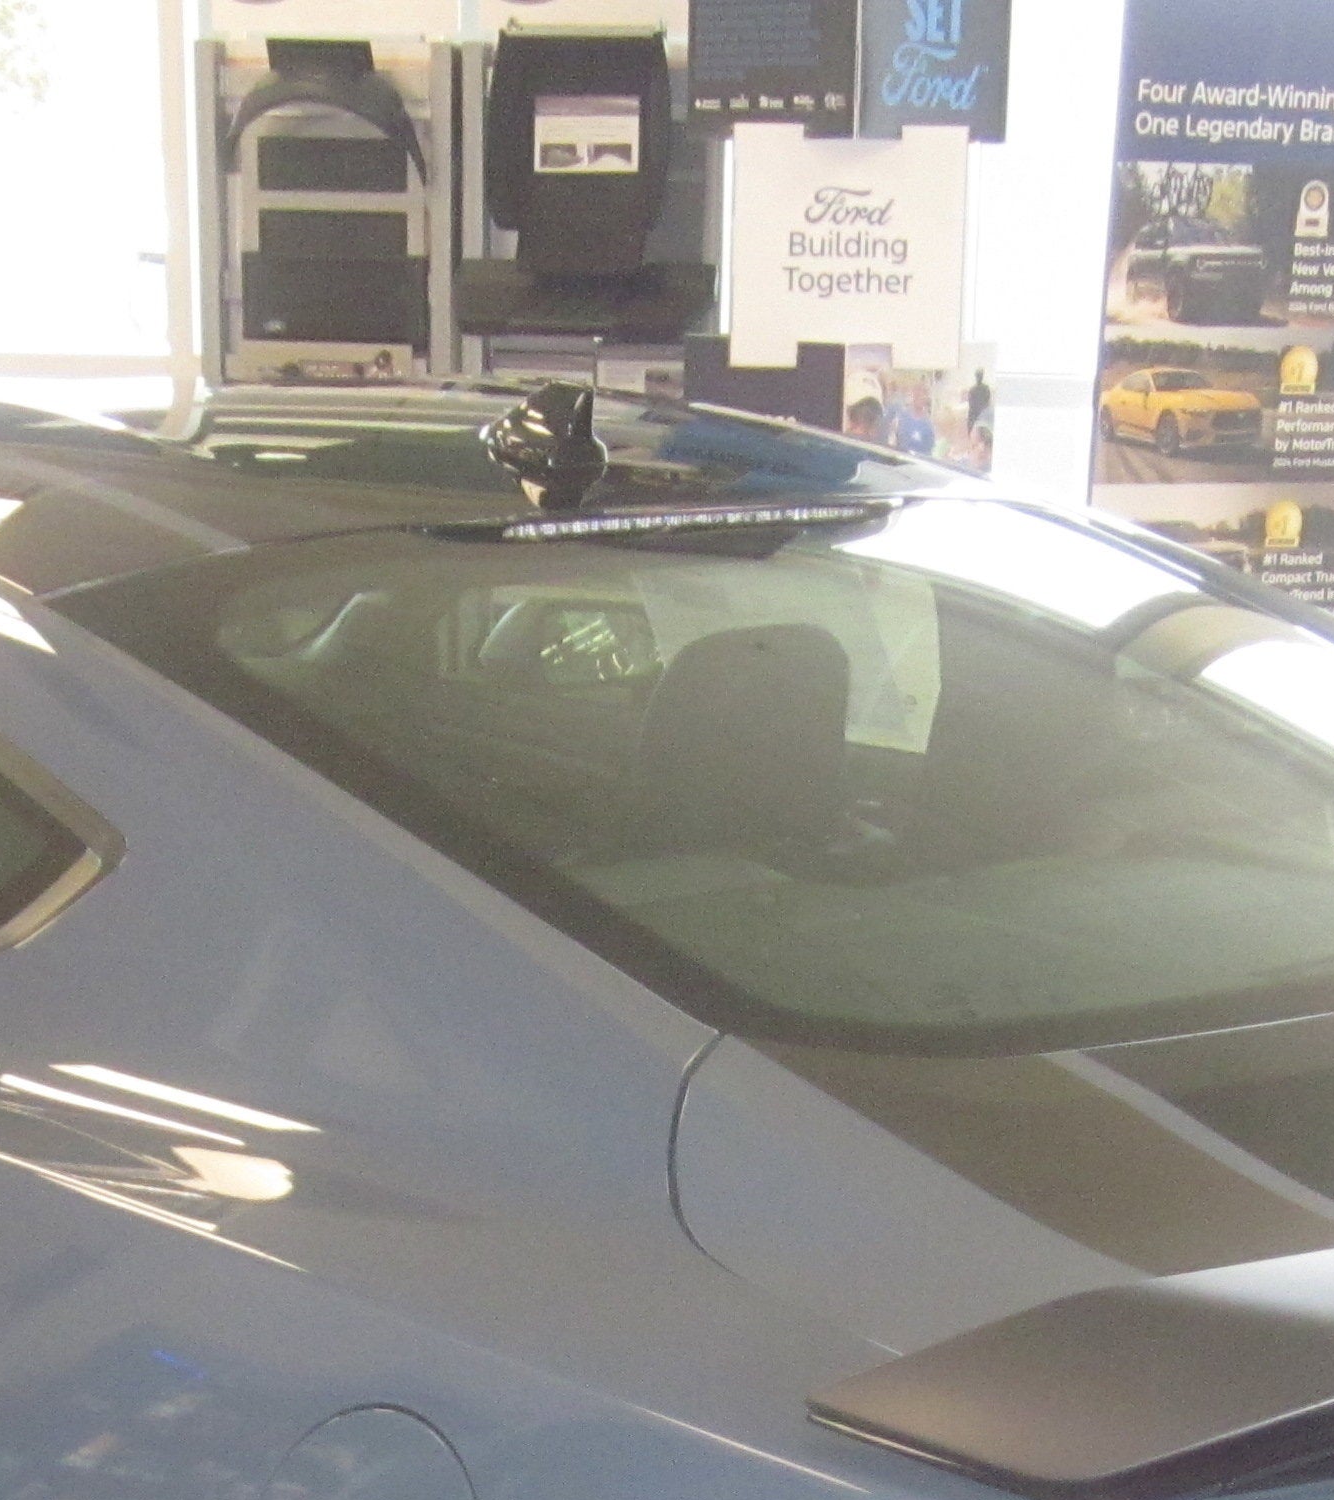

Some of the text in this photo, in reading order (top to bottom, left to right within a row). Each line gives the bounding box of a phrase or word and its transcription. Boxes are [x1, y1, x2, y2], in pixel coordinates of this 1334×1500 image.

[882, 42, 980, 110] Ford
[1137, 78, 1187, 103] Four
[1135, 111, 1179, 136] One
[1185, 114, 1294, 145] Legendary
[804, 186, 895, 225] Ford
[789, 231, 908, 264] Building
[1292, 261, 1320, 275] New
[782, 266, 913, 298] Together
[1289, 281, 1333, 298] Among
[1274, 438, 1288, 452] by
[1280, 551, 1323, 566] Ranked
[1261, 571, 1312, 585] Compact
